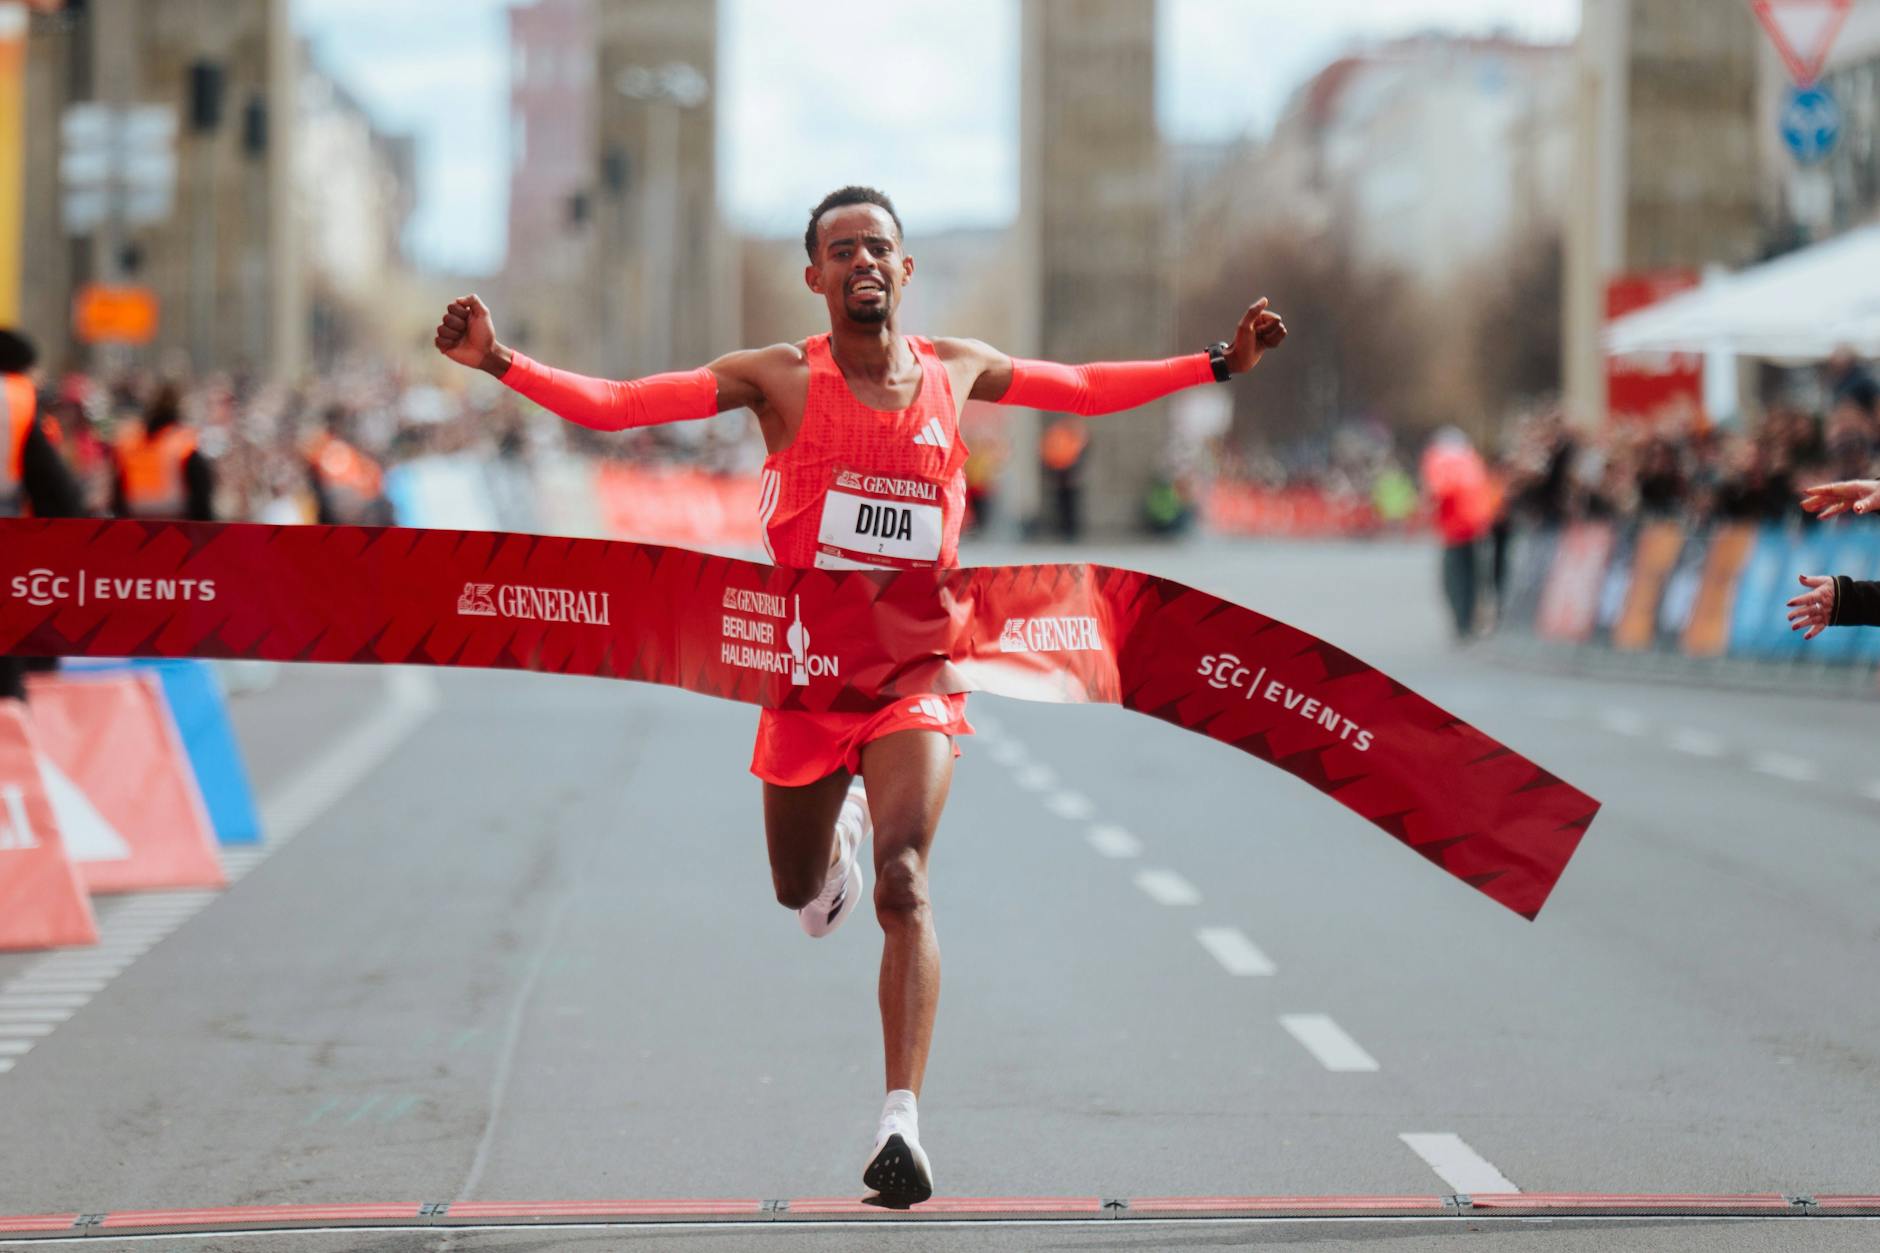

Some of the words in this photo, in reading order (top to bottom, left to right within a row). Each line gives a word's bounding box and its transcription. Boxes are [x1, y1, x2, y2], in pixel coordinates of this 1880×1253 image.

[863, 476, 938, 501] GENERALI
[855, 503, 912, 541] DIDA
[11, 575, 70, 599] SCC
[94, 577, 216, 601] EVENTS
[737, 589, 787, 618] GENERALI
[498, 584, 611, 626] GENERALI
[722, 614, 774, 645] BERLINER
[1197, 654, 1250, 688] SCC
[1263, 680, 1374, 752] EVENTS
